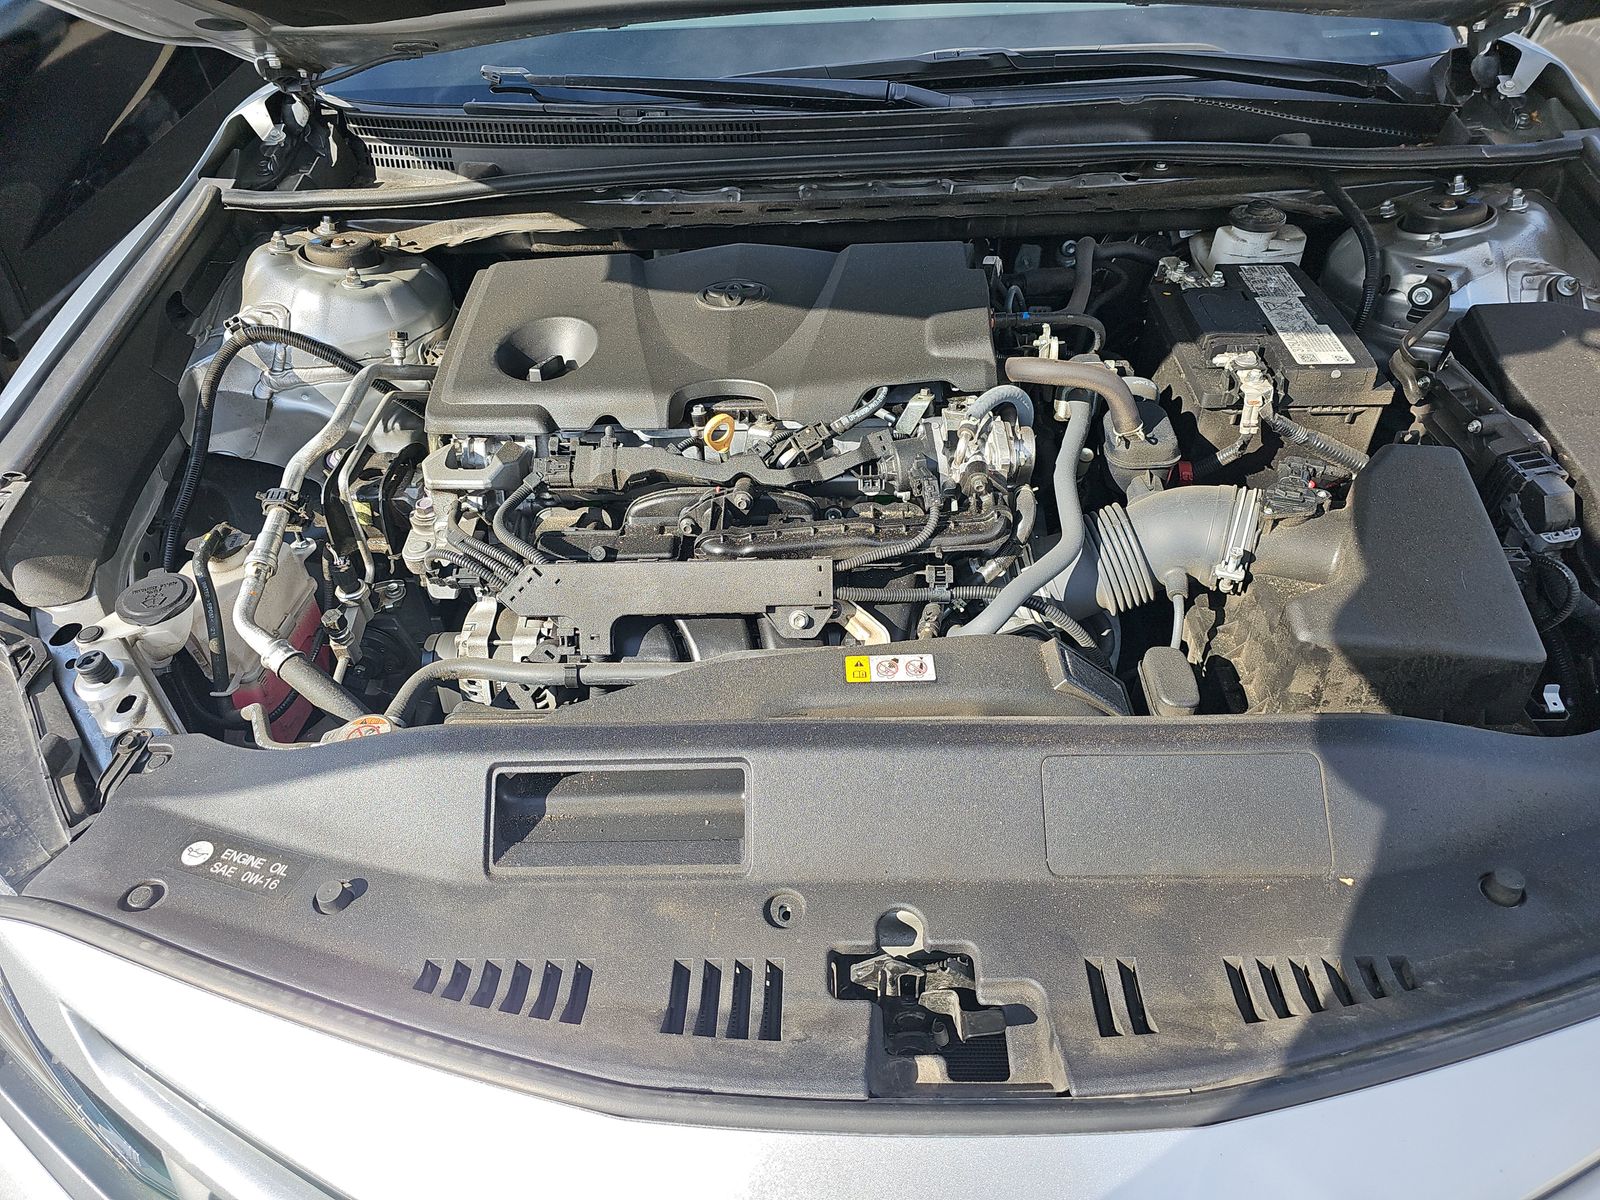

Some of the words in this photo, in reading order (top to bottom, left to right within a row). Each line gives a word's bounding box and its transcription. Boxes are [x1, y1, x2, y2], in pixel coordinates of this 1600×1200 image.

[209, 862, 238, 877] SAE
[240, 871, 280, 890] 0W-16
[220, 848, 267, 869] ENGINE
[269, 862, 289, 877] OIL
